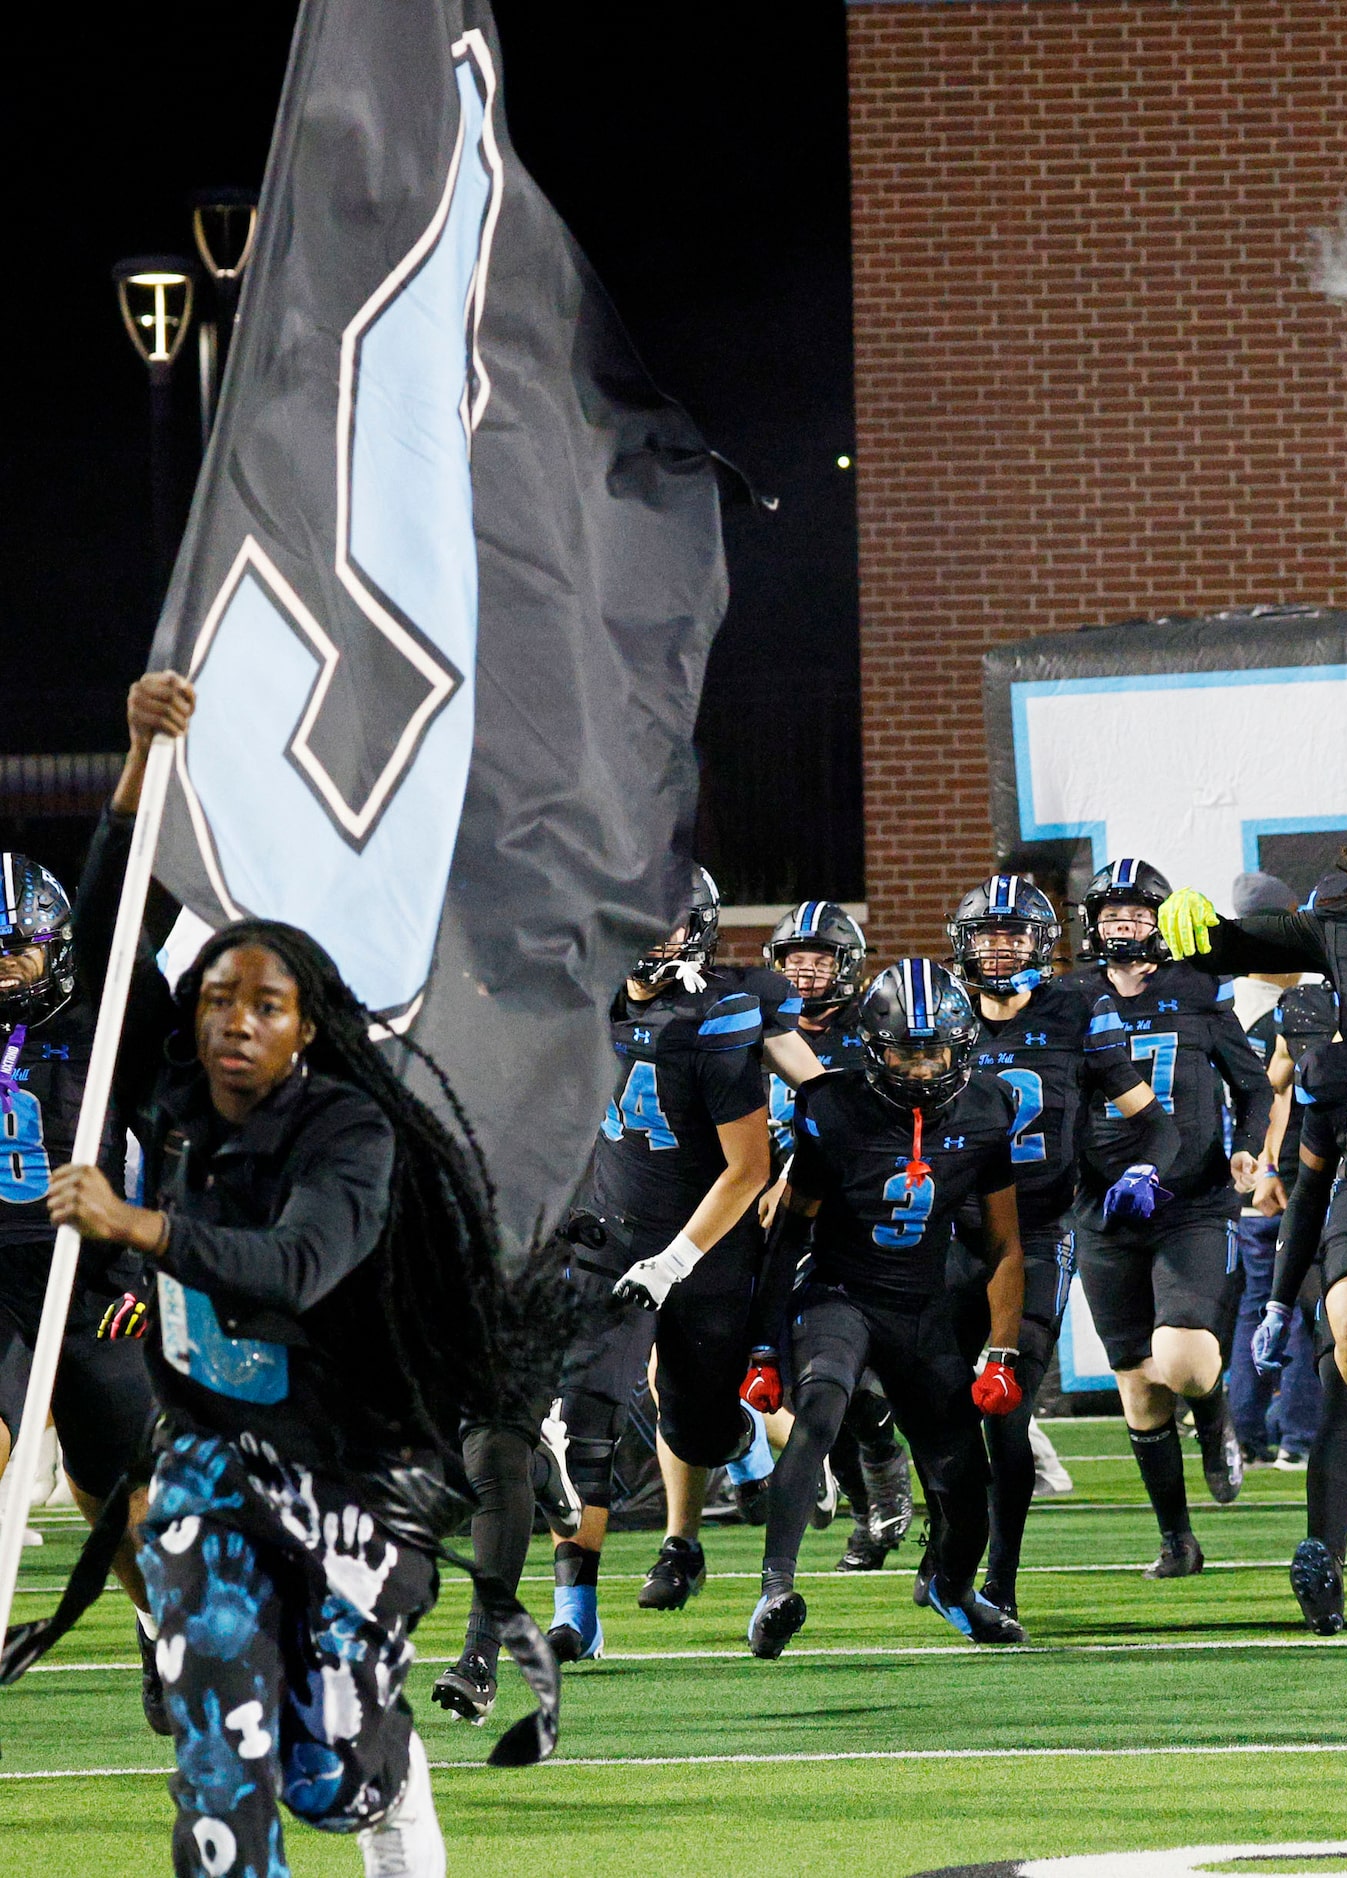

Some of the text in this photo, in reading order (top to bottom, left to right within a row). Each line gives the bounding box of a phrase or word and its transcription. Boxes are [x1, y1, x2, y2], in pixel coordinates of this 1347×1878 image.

[979, 1052, 1015, 1066] The Hill
[872, 1171, 935, 1249] 3
